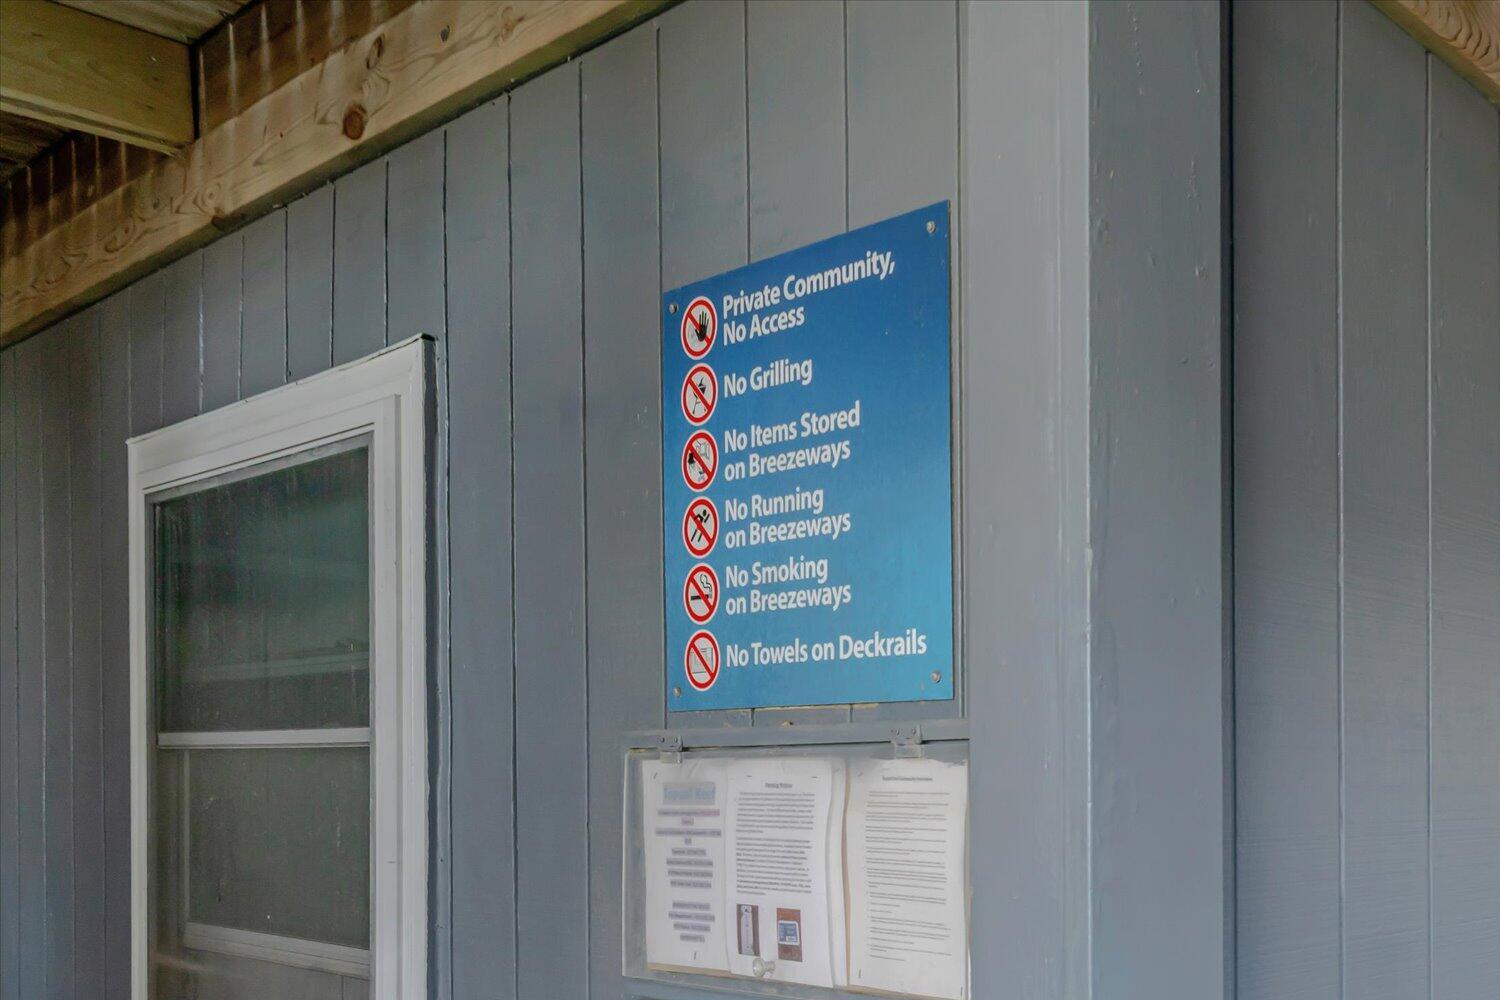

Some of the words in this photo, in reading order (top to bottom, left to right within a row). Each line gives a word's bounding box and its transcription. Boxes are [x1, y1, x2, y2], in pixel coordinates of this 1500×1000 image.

[723, 284, 780, 320] Private
[783, 250, 896, 301] Community,
[723, 321, 746, 346] No
[749, 306, 806, 339] Access
[723, 374, 747, 398] No
[750, 358, 813, 391] Grilling
[724, 429, 748, 454] No
[751, 420, 798, 447] Items
[801, 400, 860, 438] Stored
[724, 461, 746, 482] on
[750, 438, 851, 478] Breezeways
[725, 499, 748, 523] No
[751, 487, 824, 518] Running
[725, 529, 746, 549] on
[750, 512, 851, 544] Breezeways
[725, 565, 748, 589] No
[752, 555, 828, 585] Smoking
[725, 596, 747, 615] on
[750, 583, 851, 613] Breezeways
[726, 644, 749, 668] No
[751, 638, 808, 665] Towels
[811, 642, 835, 662] on
[839, 628, 927, 661] Deckrails
